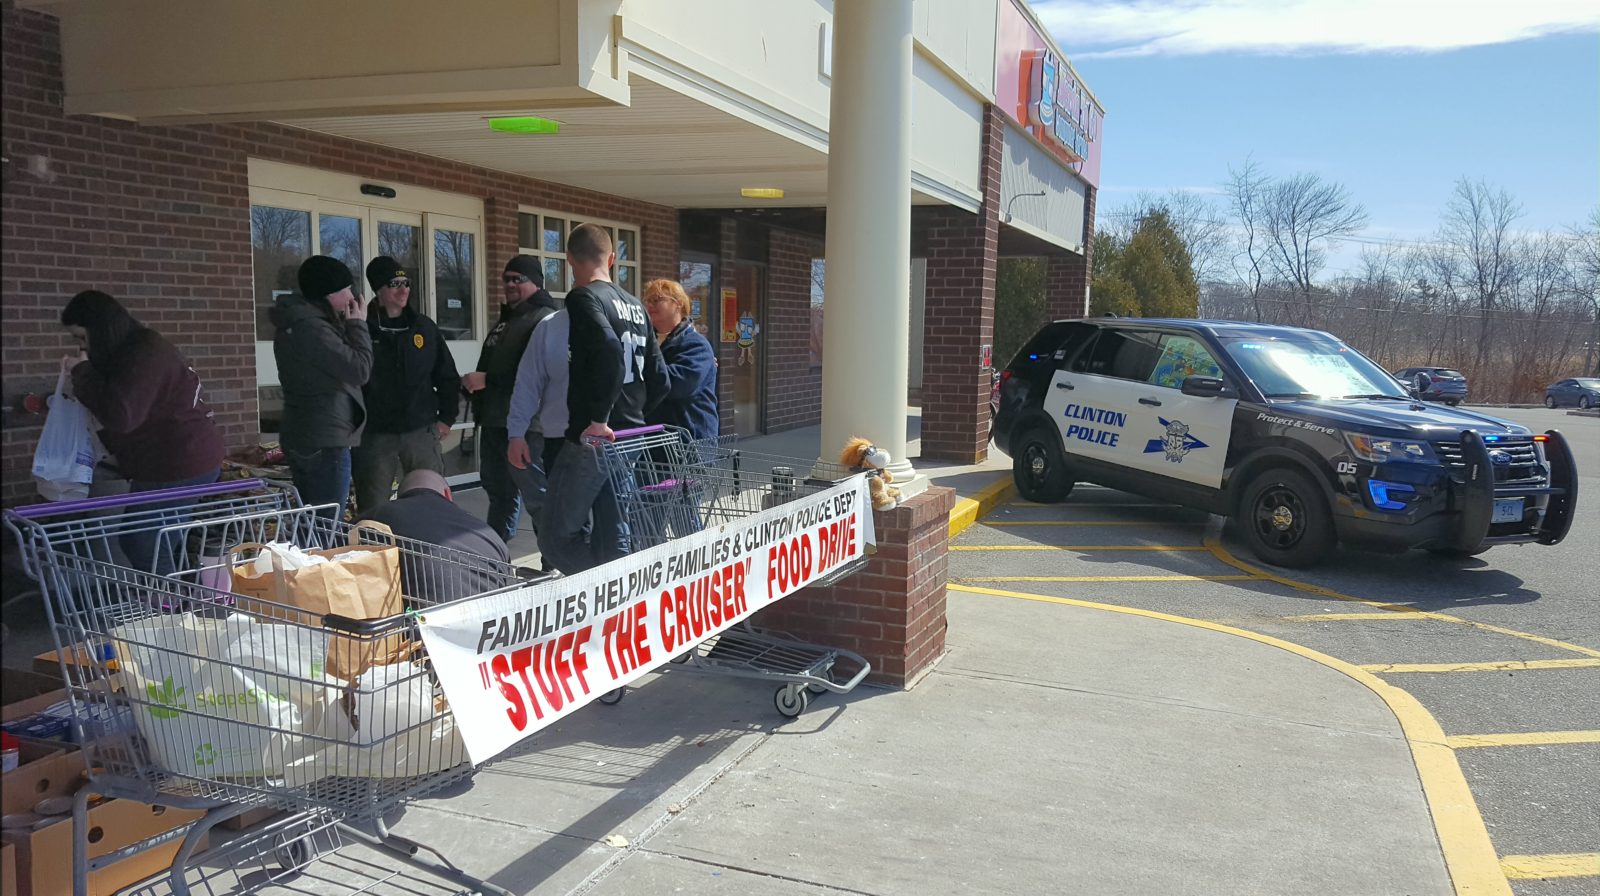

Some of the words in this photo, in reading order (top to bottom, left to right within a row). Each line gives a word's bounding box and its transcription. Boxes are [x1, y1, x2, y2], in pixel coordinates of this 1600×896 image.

[1064, 403, 1128, 428] CLINTON
[1256, 412, 1294, 426] Protect
[1293, 420, 1304, 428] &
[1302, 422, 1335, 435] Serve
[1066, 424, 1120, 448] POLICE
[1337, 461, 1358, 474] 05
[477, 590, 587, 655] FAMILIES
[593, 561, 663, 617] HELPING
[666, 537, 731, 584] FAMILIES
[732, 532, 742, 558] &
[744, 515, 794, 553] CLINTON
[795, 498, 832, 533] POLICE
[834, 489, 857, 516] DEPT
[479, 625, 593, 732] "STUFF
[602, 600, 652, 680] THE
[659, 556, 752, 654] CRUISER"
[767, 533, 813, 600] FOOD
[817, 512, 856, 574] DRIVE
